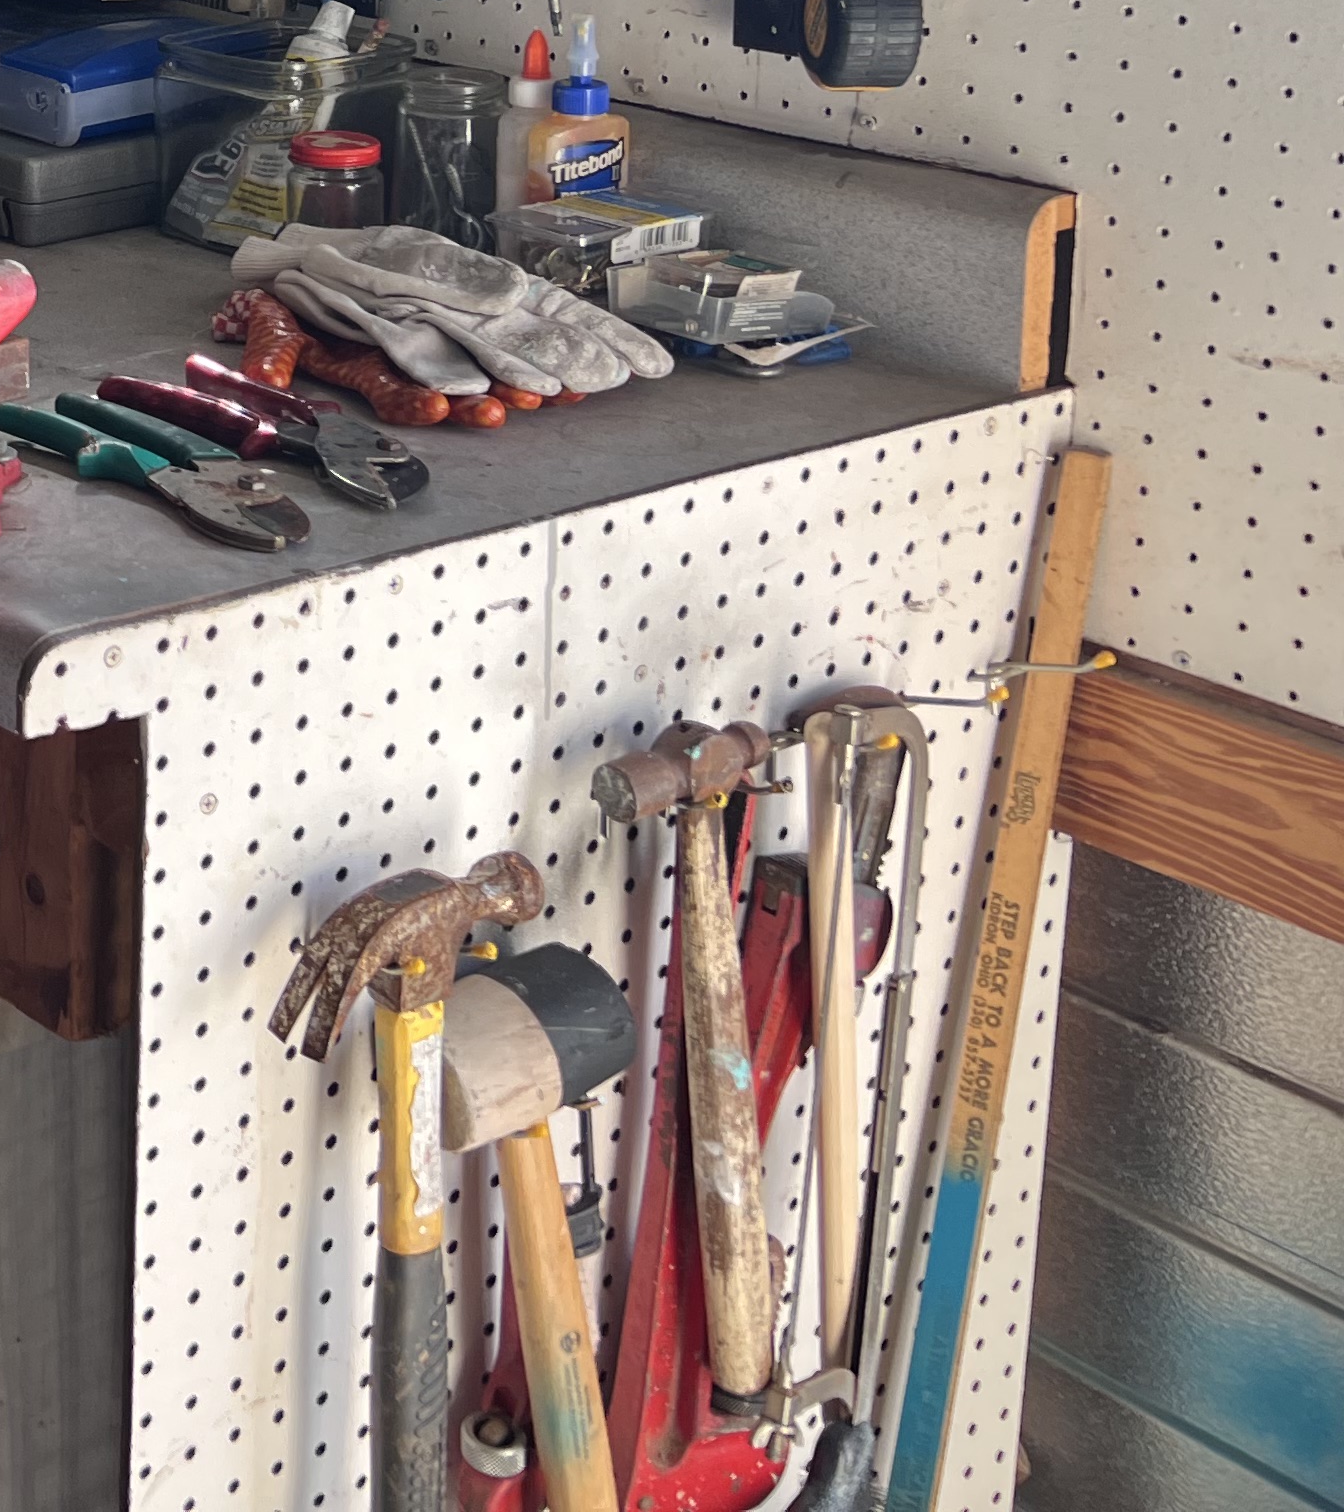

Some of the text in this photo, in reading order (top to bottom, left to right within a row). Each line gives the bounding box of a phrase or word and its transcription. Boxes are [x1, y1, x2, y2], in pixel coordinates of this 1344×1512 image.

[550, 140, 624, 184] Titebond
[1002, 899, 1020, 941] STEP
[976, 953, 994, 989] OHIO
[990, 947, 1013, 998] BACK
[985, 1006, 1004, 1029] TO
[980, 1032, 998, 1049] A
[971, 1056, 995, 1112] MORE
